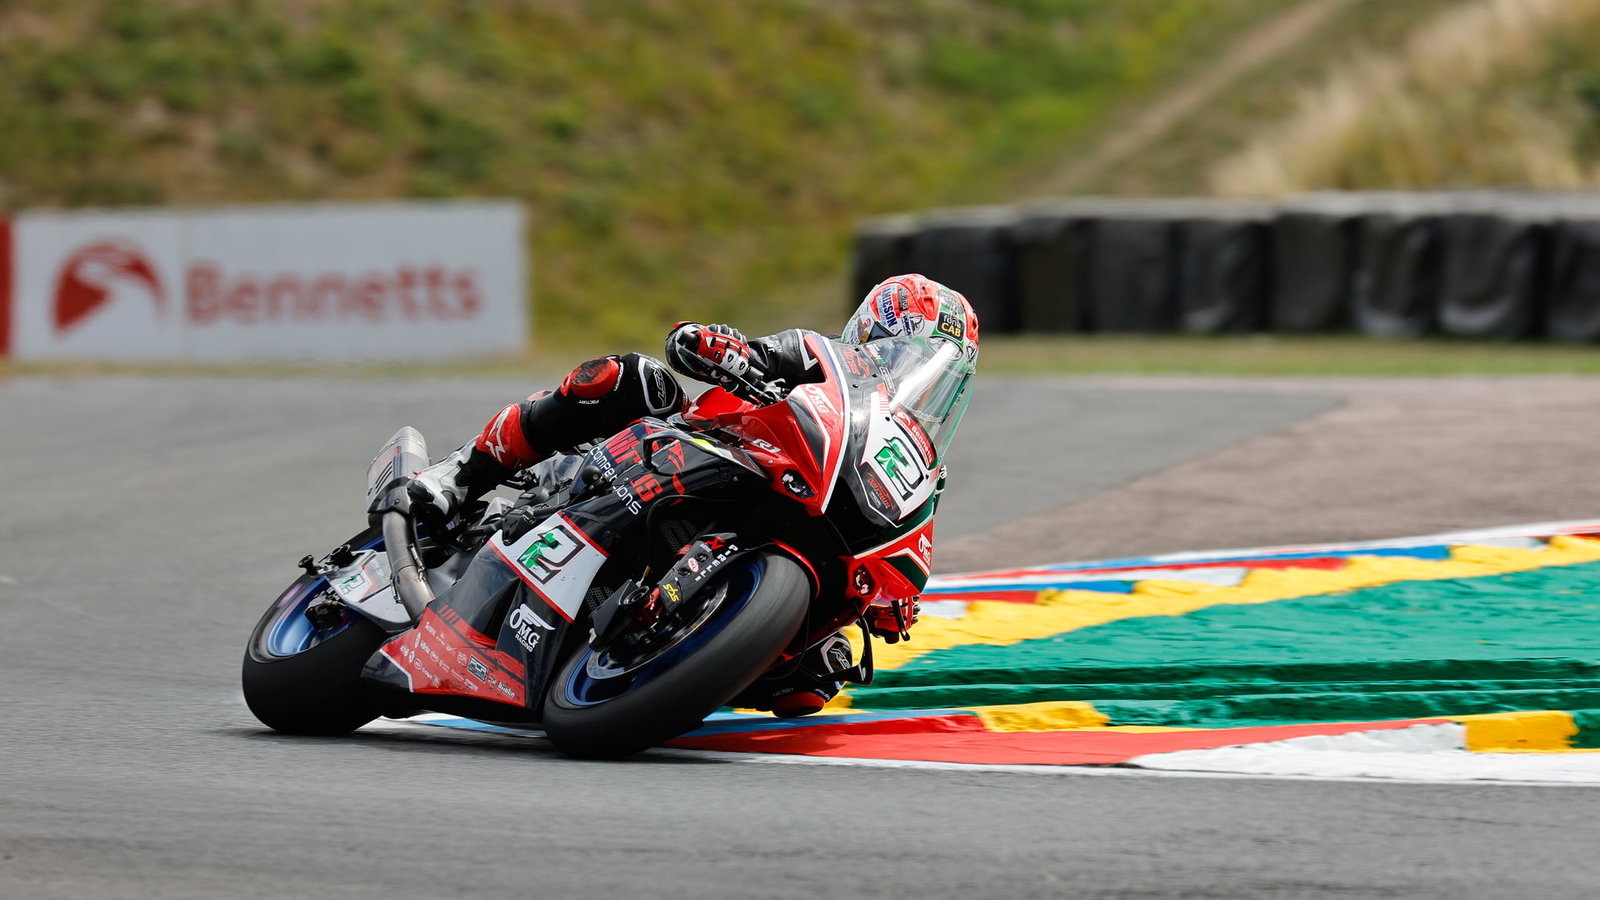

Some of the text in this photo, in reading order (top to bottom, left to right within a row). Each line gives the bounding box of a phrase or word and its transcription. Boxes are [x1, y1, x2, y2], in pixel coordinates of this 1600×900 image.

[186, 262, 480, 324] Bennetts
[941, 323, 962, 337] CAB
[752, 438, 781, 453] R1
[911, 425, 934, 463] Bennetts
[606, 428, 664, 502] Nitrs
[874, 436, 924, 502] 2
[516, 524, 586, 585] 2
[695, 544, 739, 582] PIRELLI
[509, 606, 542, 648] OMG
[515, 633, 535, 653] RACING
[829, 647, 852, 670] RS
